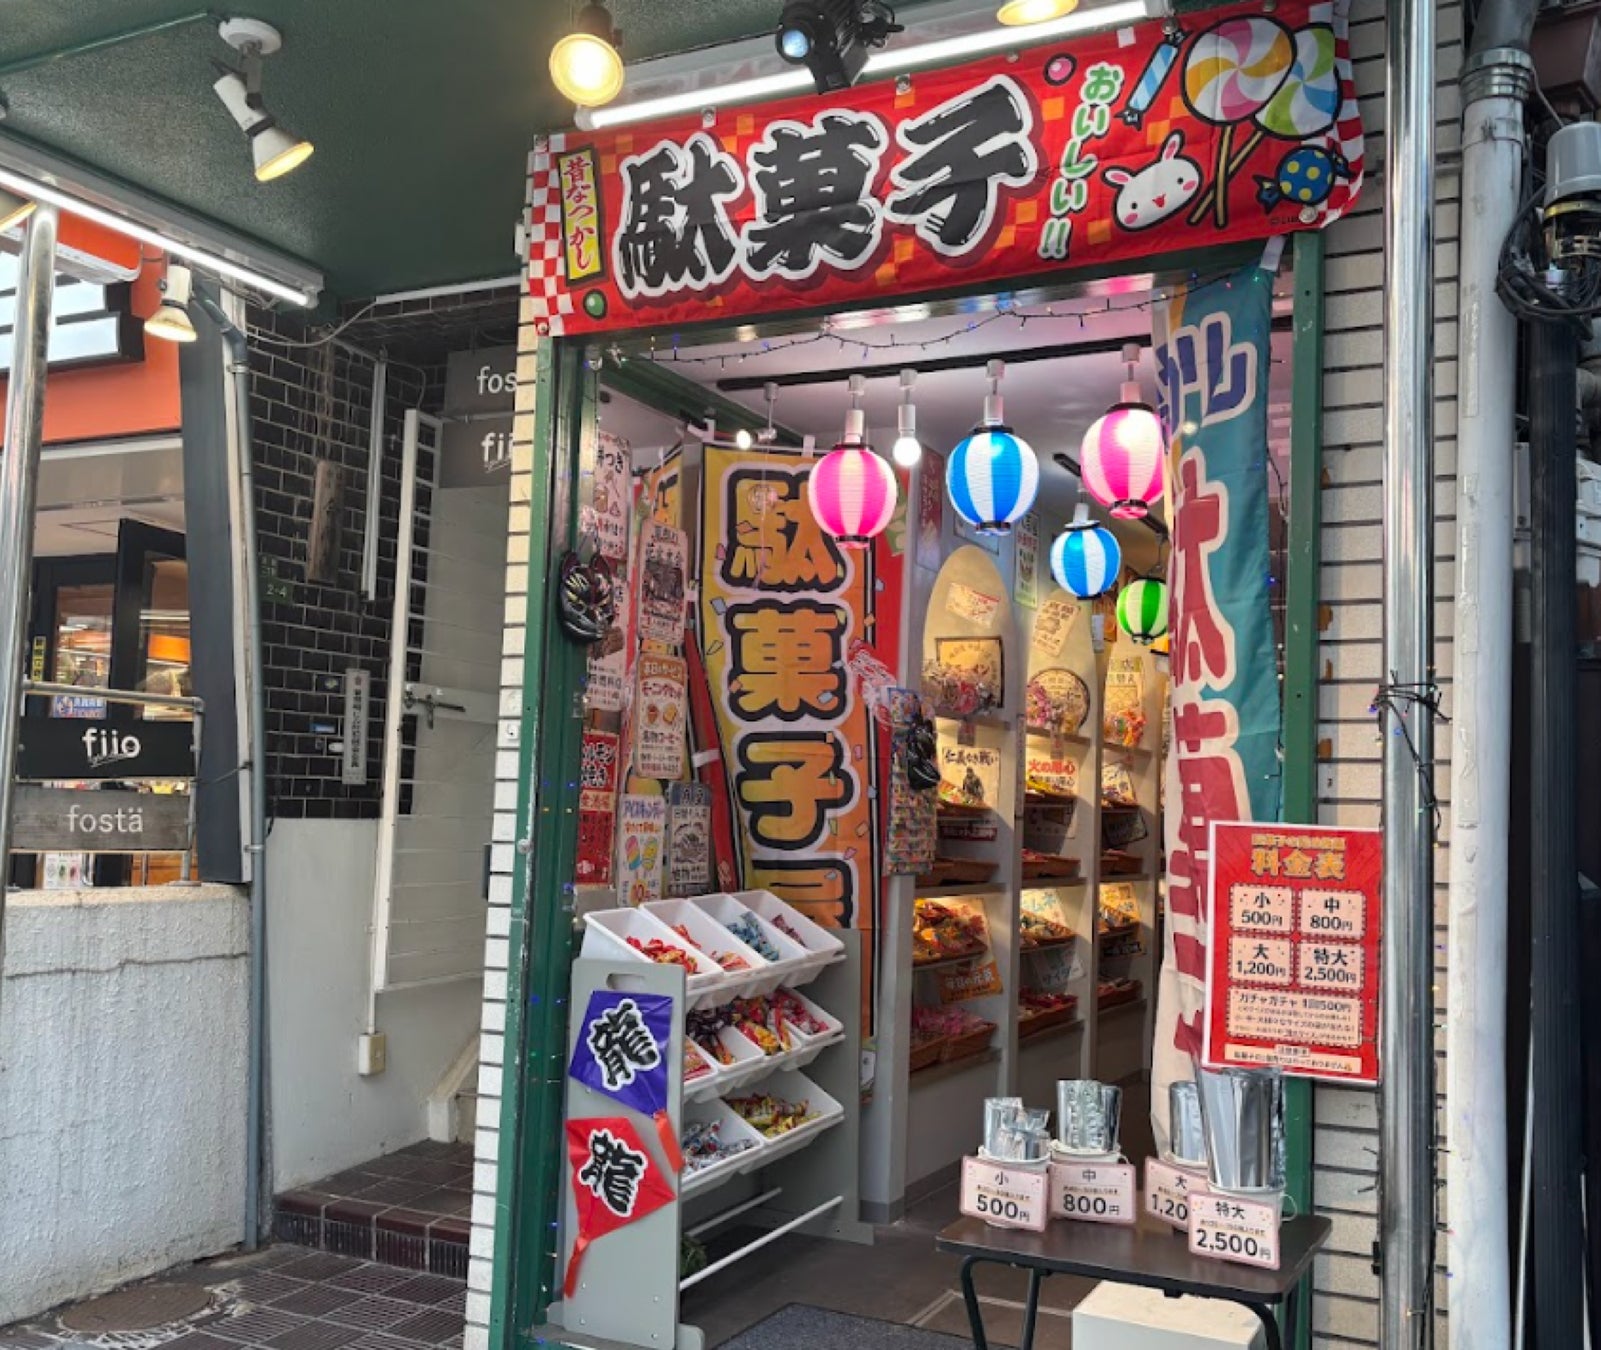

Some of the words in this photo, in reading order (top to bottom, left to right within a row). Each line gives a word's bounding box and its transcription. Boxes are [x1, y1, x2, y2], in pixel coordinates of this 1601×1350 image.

[614, 78, 1036, 298] 駄菓子
[564, 154, 594, 272] 昔なつかし
[82, 727, 141, 758] fiio
[67, 805, 144, 833] fostä
[1251, 849, 1347, 881] 料金表
[1253, 891, 1271, 909] 小
[1324, 897, 1340, 914] 中
[1241, 911, 1283, 927] 500円
[1310, 915, 1352, 931] 800円
[1253, 943, 1270, 960] 大
[1314, 949, 1348, 966] 特大
[1235, 960, 1286, 978] 1,200円
[1304, 966, 1356, 984] 2,500円
[995, 1171, 1009, 1185] 小
[1082, 1169, 1097, 1183] 中
[1174, 1175, 1188, 1190] 大
[976, 1195, 1030, 1222] 500円
[1063, 1197, 1120, 1216] 800円
[1215, 1200, 1246, 1220] 特大
[1196, 1228, 1271, 1260] 2,500円
